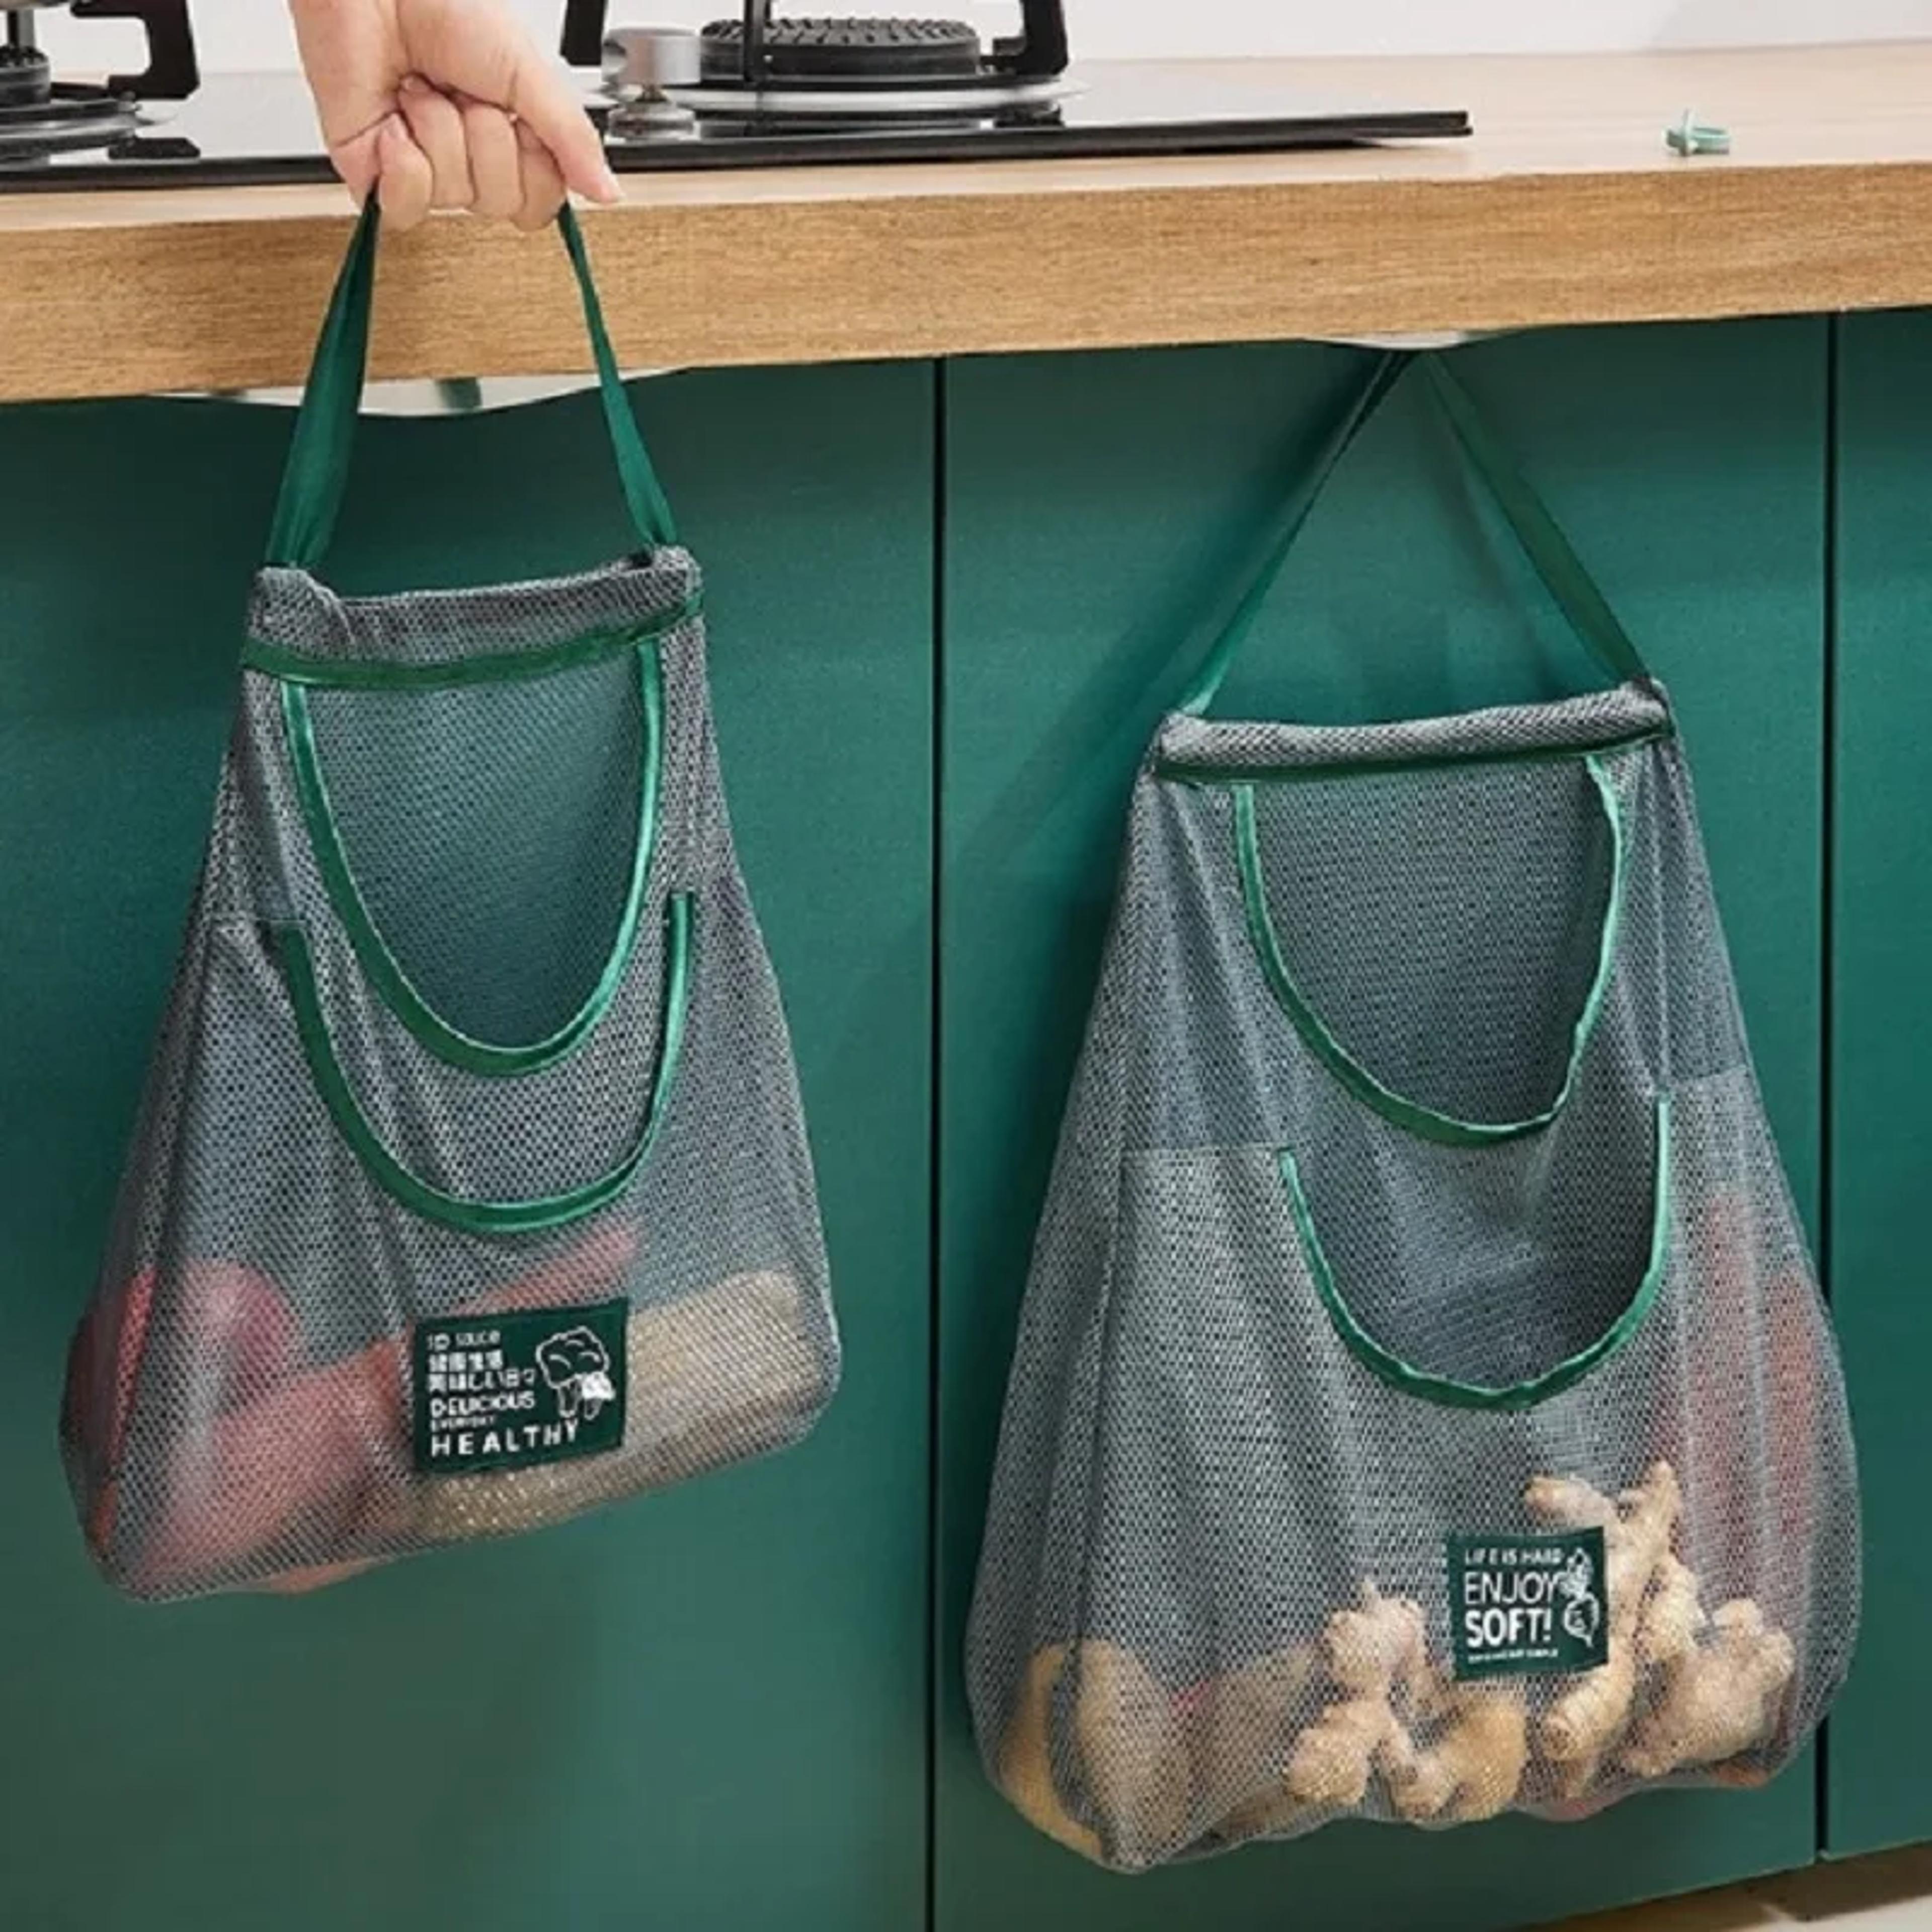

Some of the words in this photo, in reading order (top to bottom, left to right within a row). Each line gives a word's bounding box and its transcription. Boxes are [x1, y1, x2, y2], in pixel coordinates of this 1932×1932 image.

[430, 1390, 535, 1419] DELICIOUS
[431, 1417, 579, 1458] HEALTHY
[1502, 1547, 1517, 1566] IS
[1464, 1570, 1563, 1605] ENJOY
[1465, 1606, 1552, 1648] SOFT!
